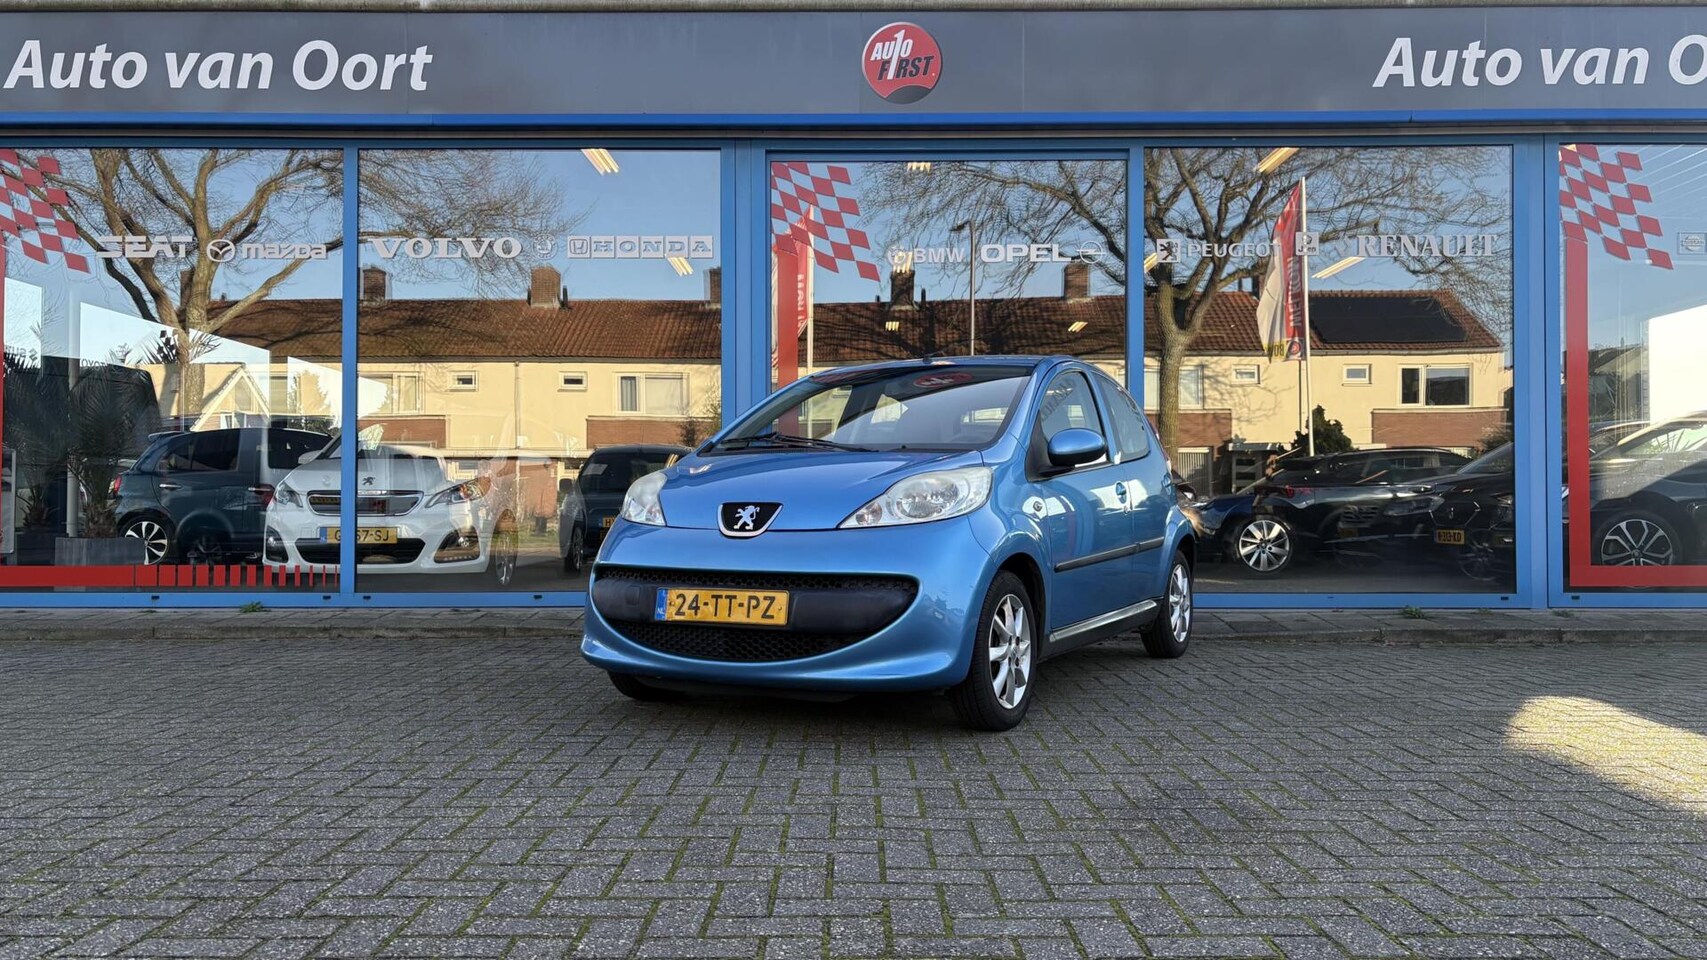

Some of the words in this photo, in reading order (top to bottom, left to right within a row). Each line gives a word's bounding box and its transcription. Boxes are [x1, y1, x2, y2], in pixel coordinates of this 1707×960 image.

[3, 39, 148, 89] Auto
[165, 51, 274, 89] van
[292, 39, 434, 91] Oort
[1372, 37, 1523, 87] Auto
[1540, 47, 1649, 86] van
[97, 235, 193, 258] SEAT
[367, 237, 523, 259] VOLVO
[592, 237, 712, 256] HONDA
[913, 248, 965, 264] BMW
[980, 243, 1072, 263] OPEL
[1187, 242, 1282, 258] PEUGEOT
[1356, 234, 1498, 257] RENAULT
[334, 529, 389, 542] G57-SJ
[674, 593, 776, 620] 24-TT-PZ
